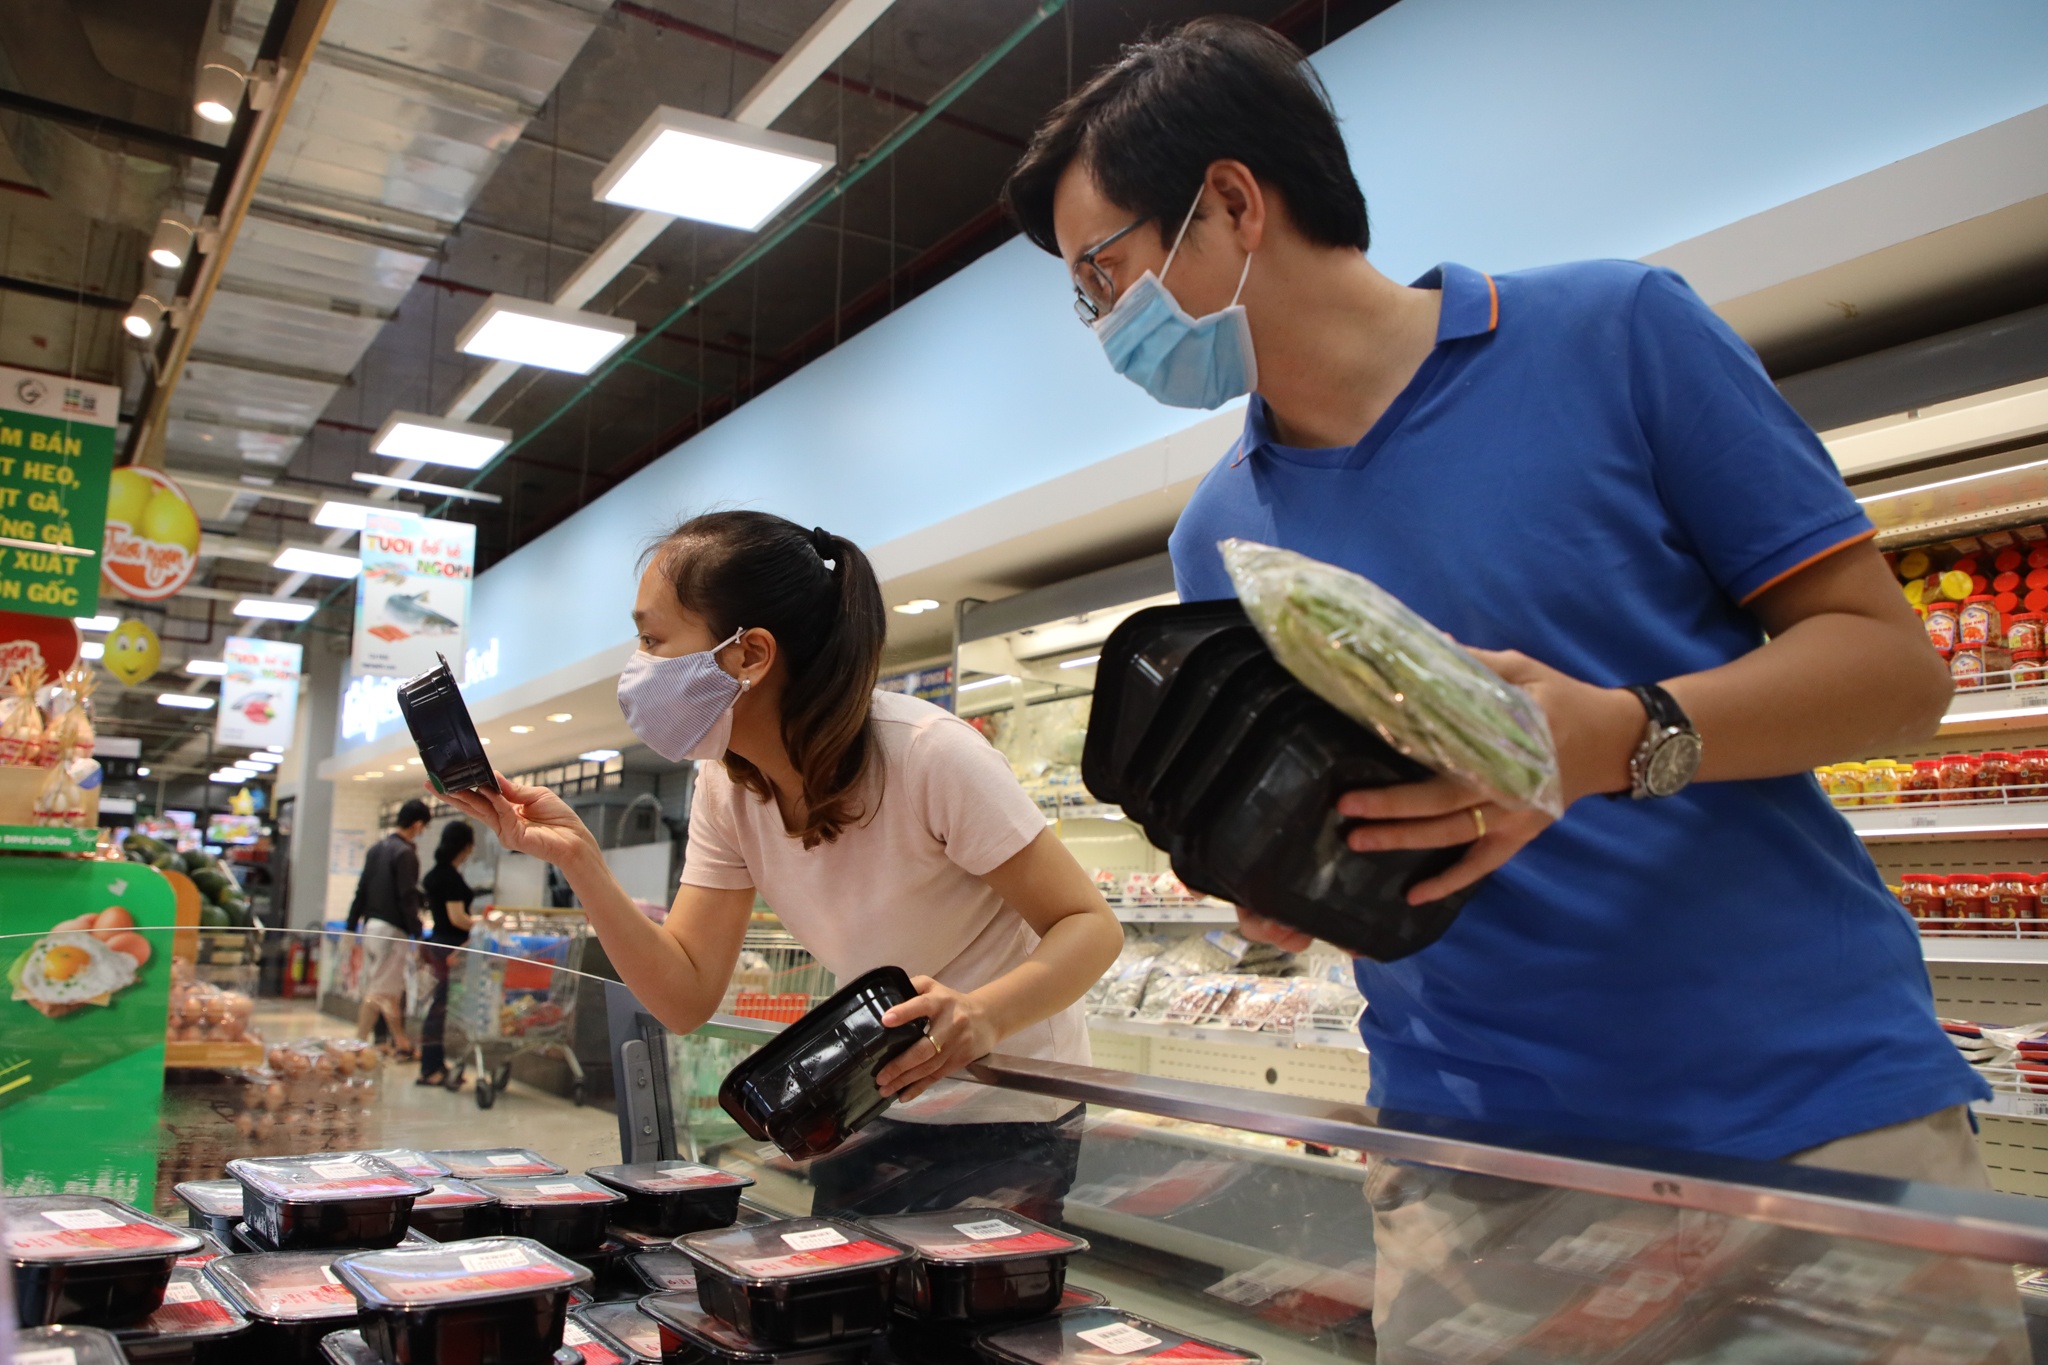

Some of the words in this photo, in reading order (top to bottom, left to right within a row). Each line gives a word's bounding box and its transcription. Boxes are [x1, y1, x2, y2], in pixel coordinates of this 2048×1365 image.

[30, 430, 81, 457] BÁN
[23, 460, 80, 489] HEO,
[28, 489, 69, 518] GÀ,
[41, 522, 74, 545] GÀ
[27, 579, 78, 606] GỐC
